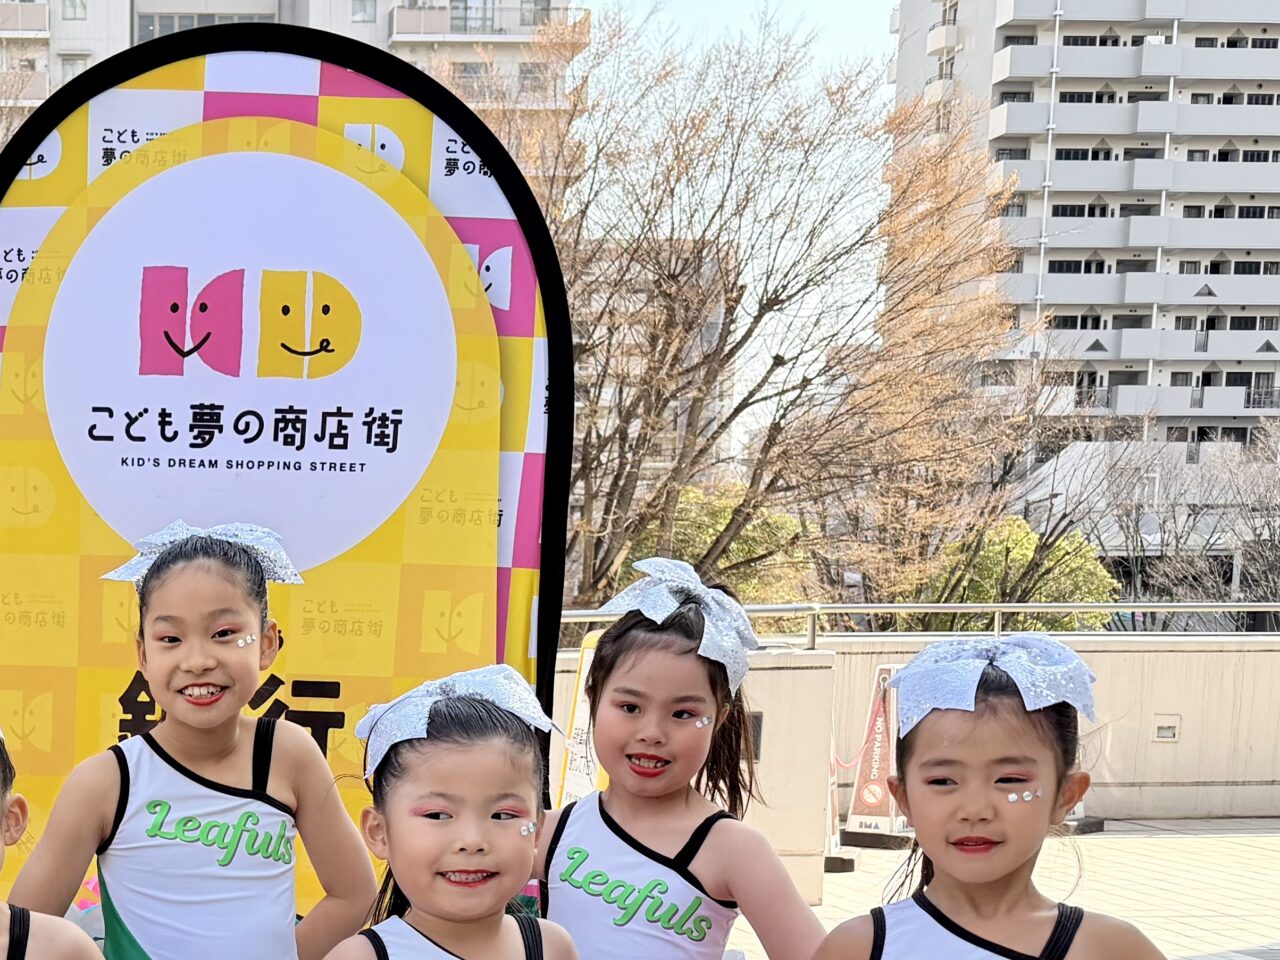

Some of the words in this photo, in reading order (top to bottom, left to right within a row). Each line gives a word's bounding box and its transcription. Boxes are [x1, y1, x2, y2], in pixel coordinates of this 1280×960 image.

[87, 403, 404, 454] こども夢の商店街
[121, 457, 161, 468] KID'S
[168, 458, 219, 469] DREAM
[226, 460, 303, 472] SHOPPING
[310, 462, 367, 473] STREET
[875, 716, 885, 733] NO
[870, 734, 884, 780] PARKING
[145, 799, 293, 867] Leafuls
[559, 846, 713, 942] Leafuls
